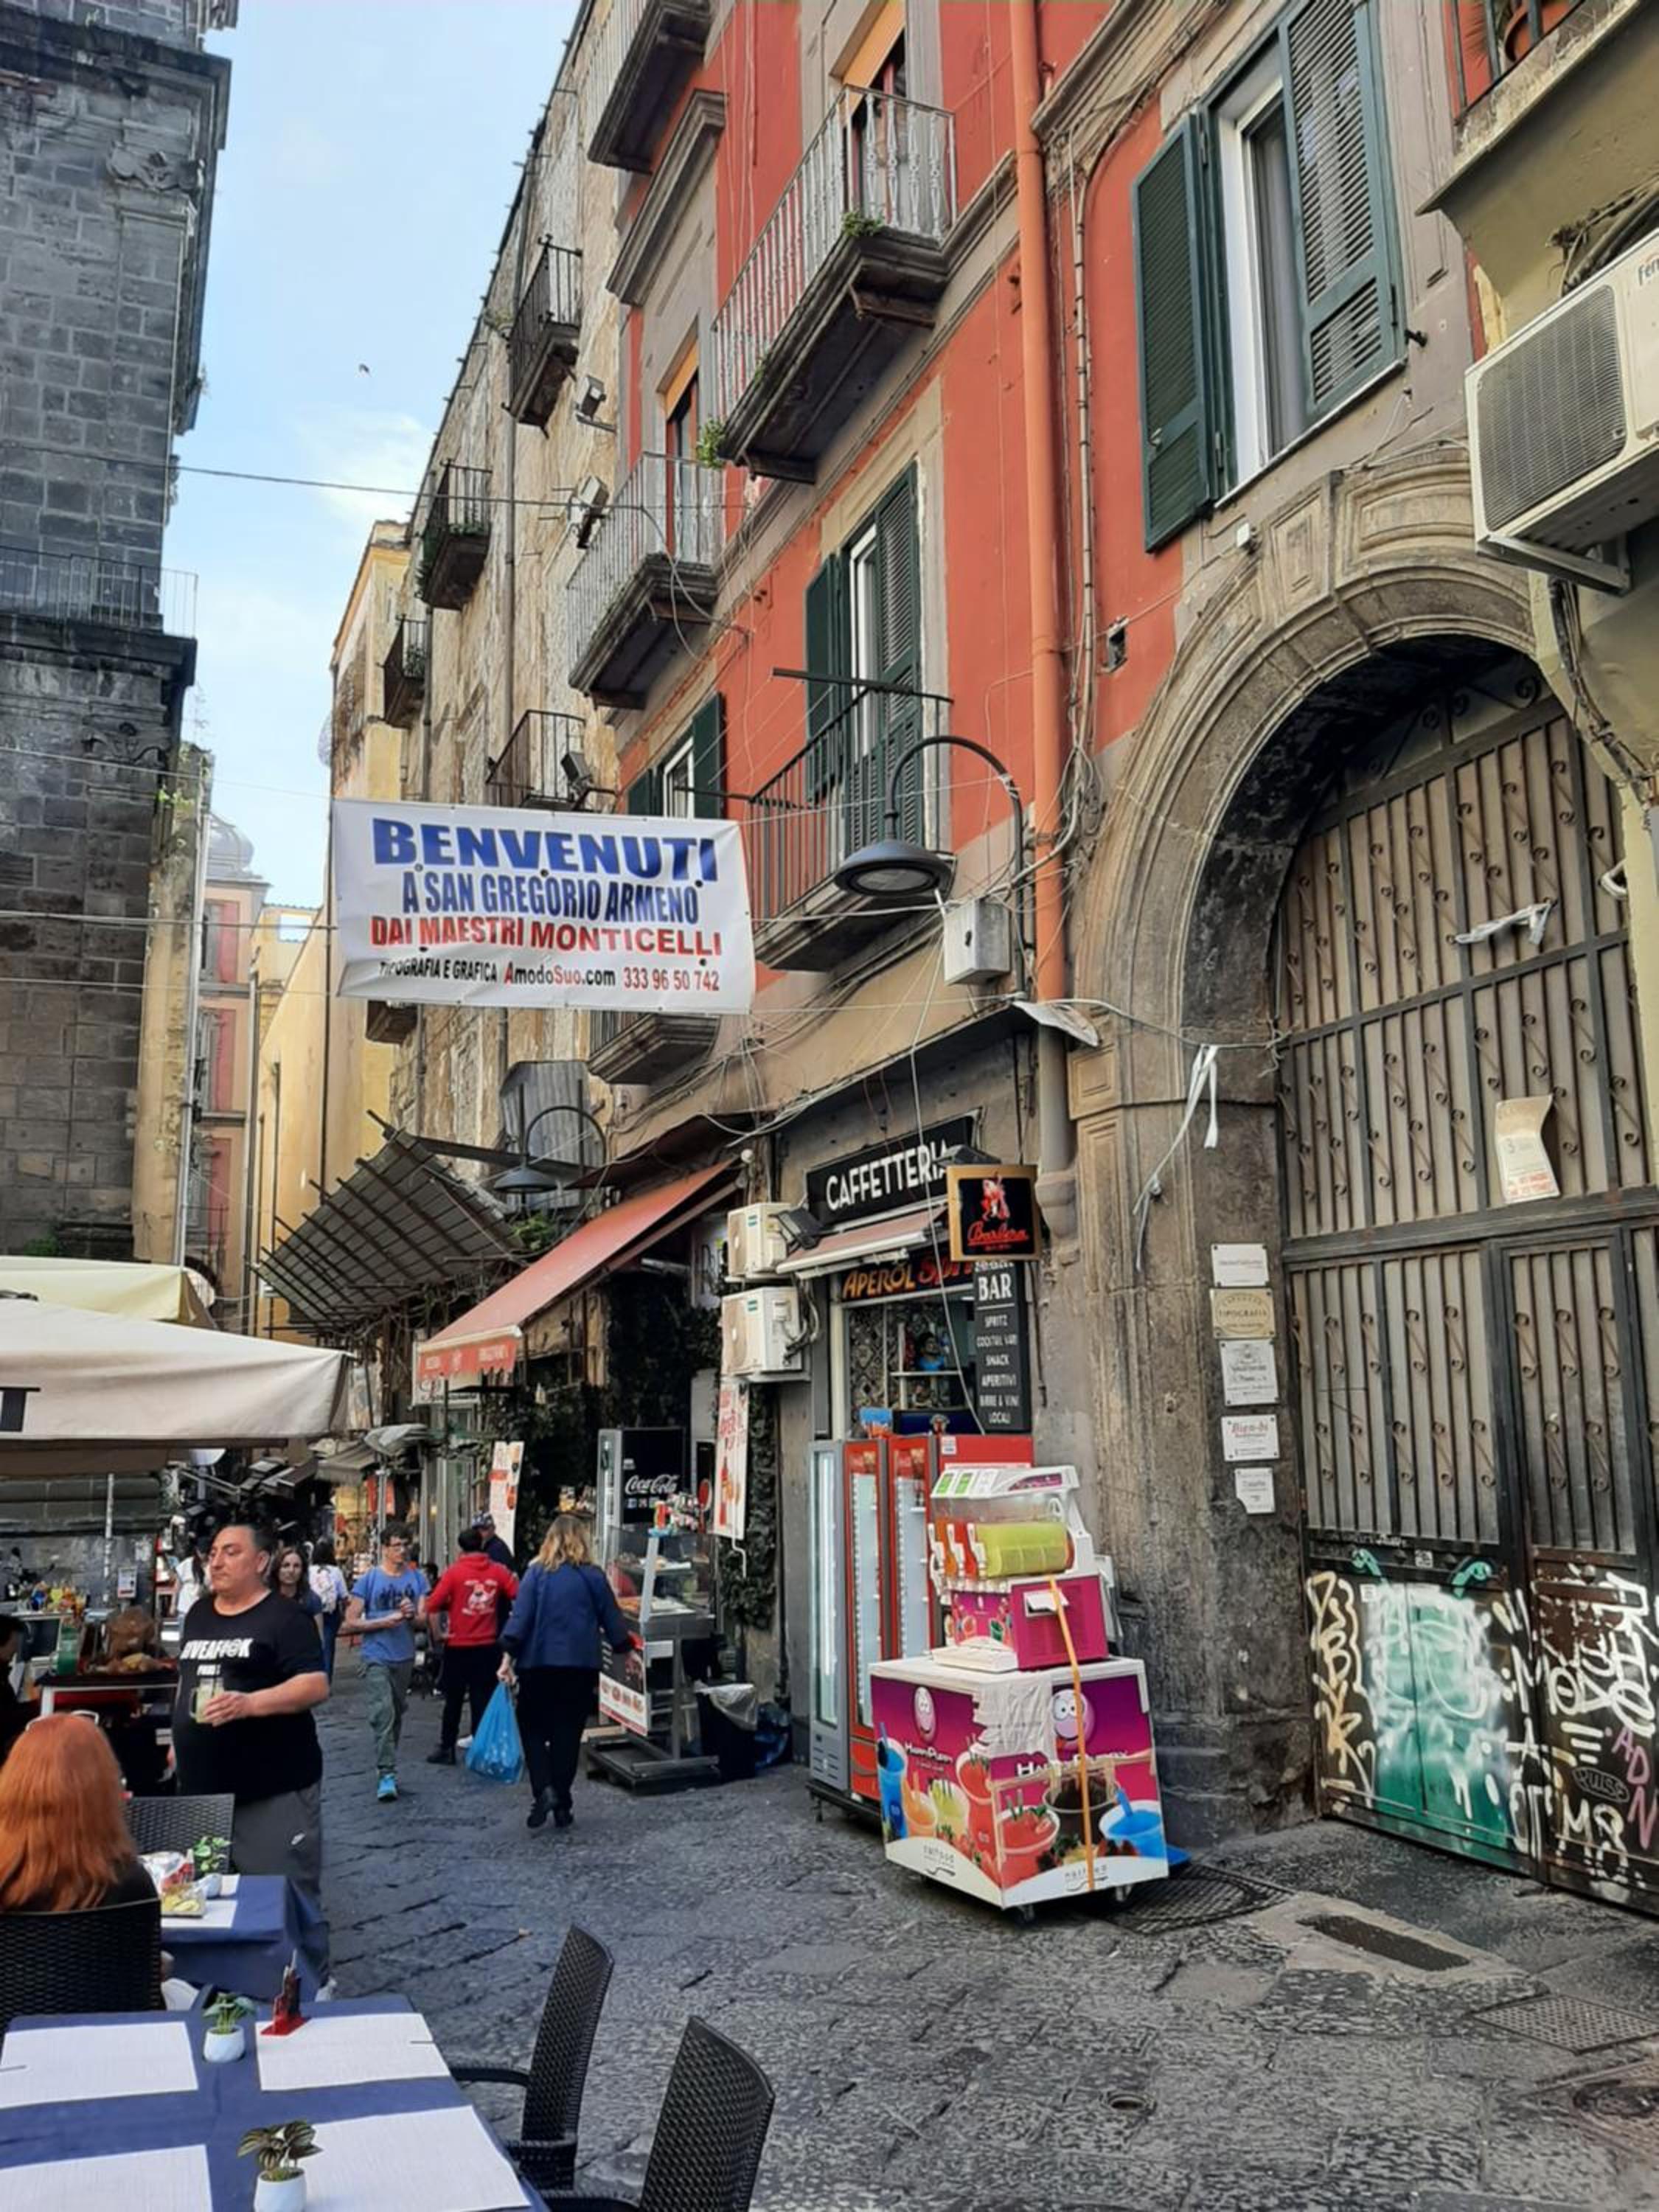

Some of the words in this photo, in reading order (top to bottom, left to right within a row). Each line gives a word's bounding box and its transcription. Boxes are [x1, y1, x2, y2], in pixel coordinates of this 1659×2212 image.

[372, 818, 718, 883] BENVENUTI
[403, 872, 420, 914] A
[424, 872, 475, 913] SAN
[481, 873, 601, 921] GREGORIO
[605, 881, 698, 925] ARMENO
[371, 915, 412, 946] DAI
[419, 916, 524, 947] MAESTRI
[530, 921, 722, 956] MONTICELLI
[443, 959, 451, 979] E
[453, 960, 498, 982] GRAFICA
[504, 961, 616, 986] AmodoSuo.com
[624, 967, 648, 989] 333
[652, 968, 669, 990] 96
[673, 970, 690, 990] 50
[694, 970, 720, 992] 742
[842, 1262, 917, 1299] APEROL
[978, 1273, 1012, 1301] BAR
